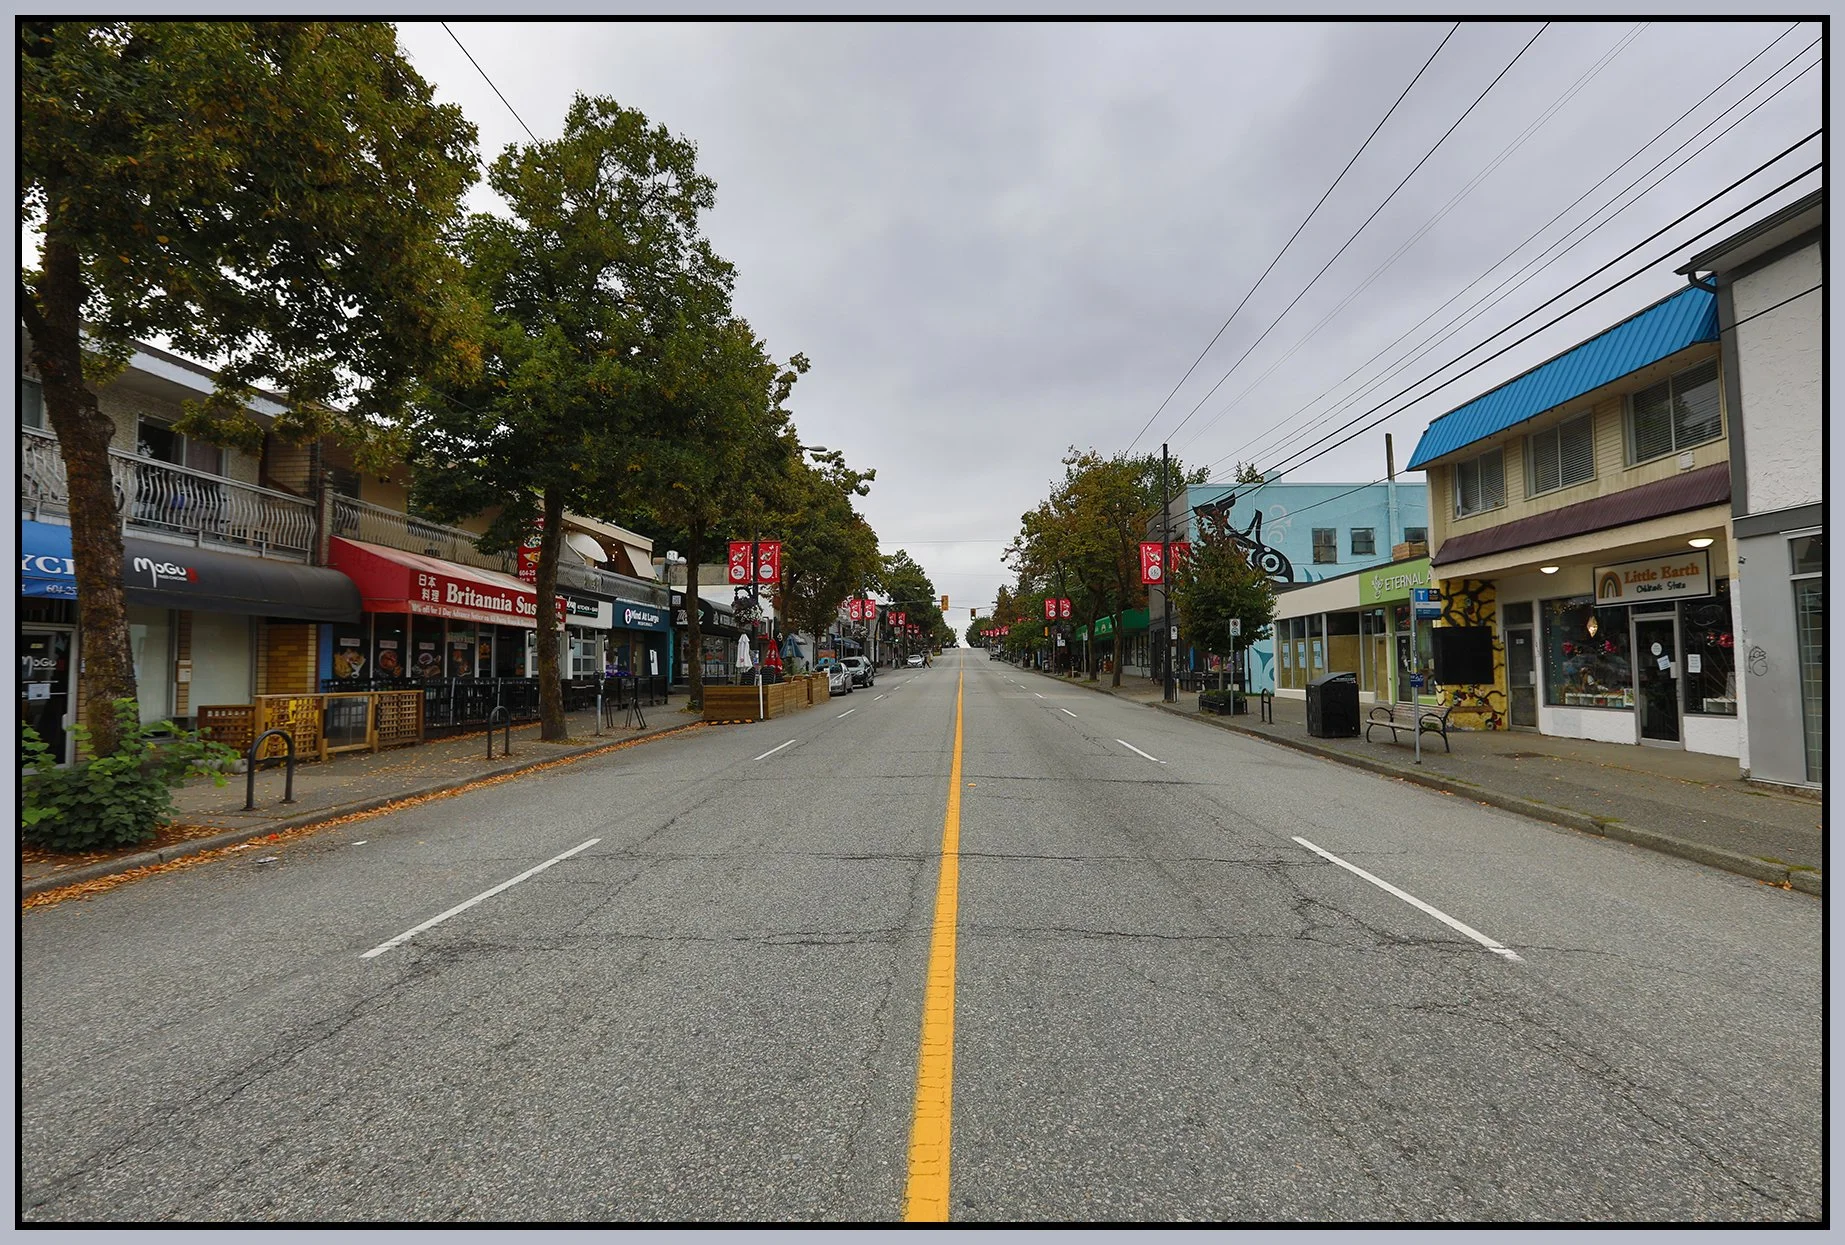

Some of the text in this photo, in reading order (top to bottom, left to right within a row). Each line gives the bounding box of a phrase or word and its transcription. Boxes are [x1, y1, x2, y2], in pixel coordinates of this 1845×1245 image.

[418, 573, 437, 588] 日本
[1624, 562, 1700, 584] Little Earth
[1385, 571, 1424, 591] ETERNAL
[421, 588, 440, 603] 料理
[446, 582, 512, 612] Britannia
[1417, 590, 1425, 600] T
[647, 612, 659, 624] Large
